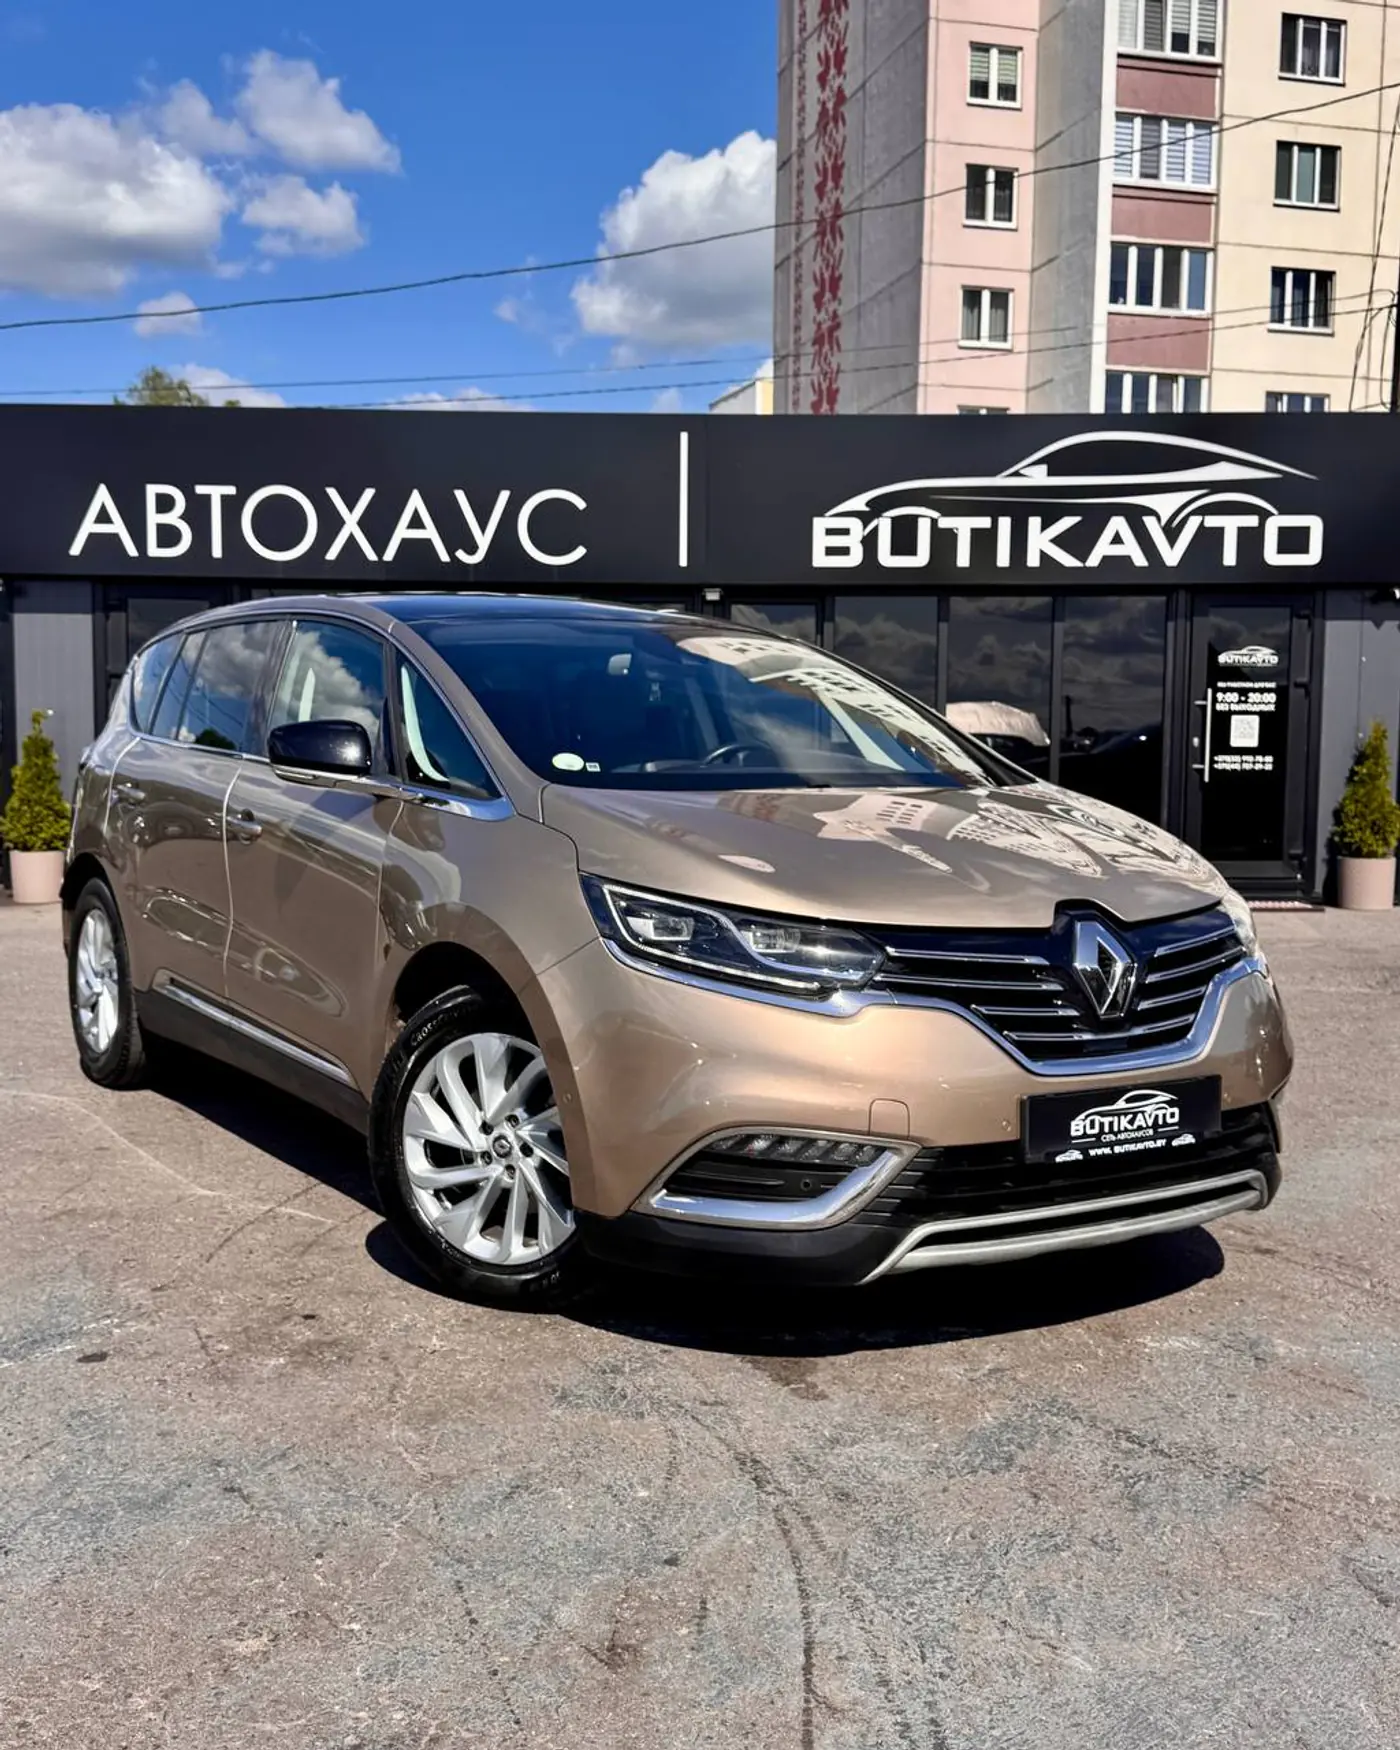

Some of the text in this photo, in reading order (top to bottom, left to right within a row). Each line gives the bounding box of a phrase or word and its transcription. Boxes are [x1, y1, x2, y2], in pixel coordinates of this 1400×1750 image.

[69, 483, 587, 565] АВТОХАУС
[812, 515, 1323, 567] BUTIKAVTO
[1070, 1107, 1180, 1137] BUTIKAVTO
